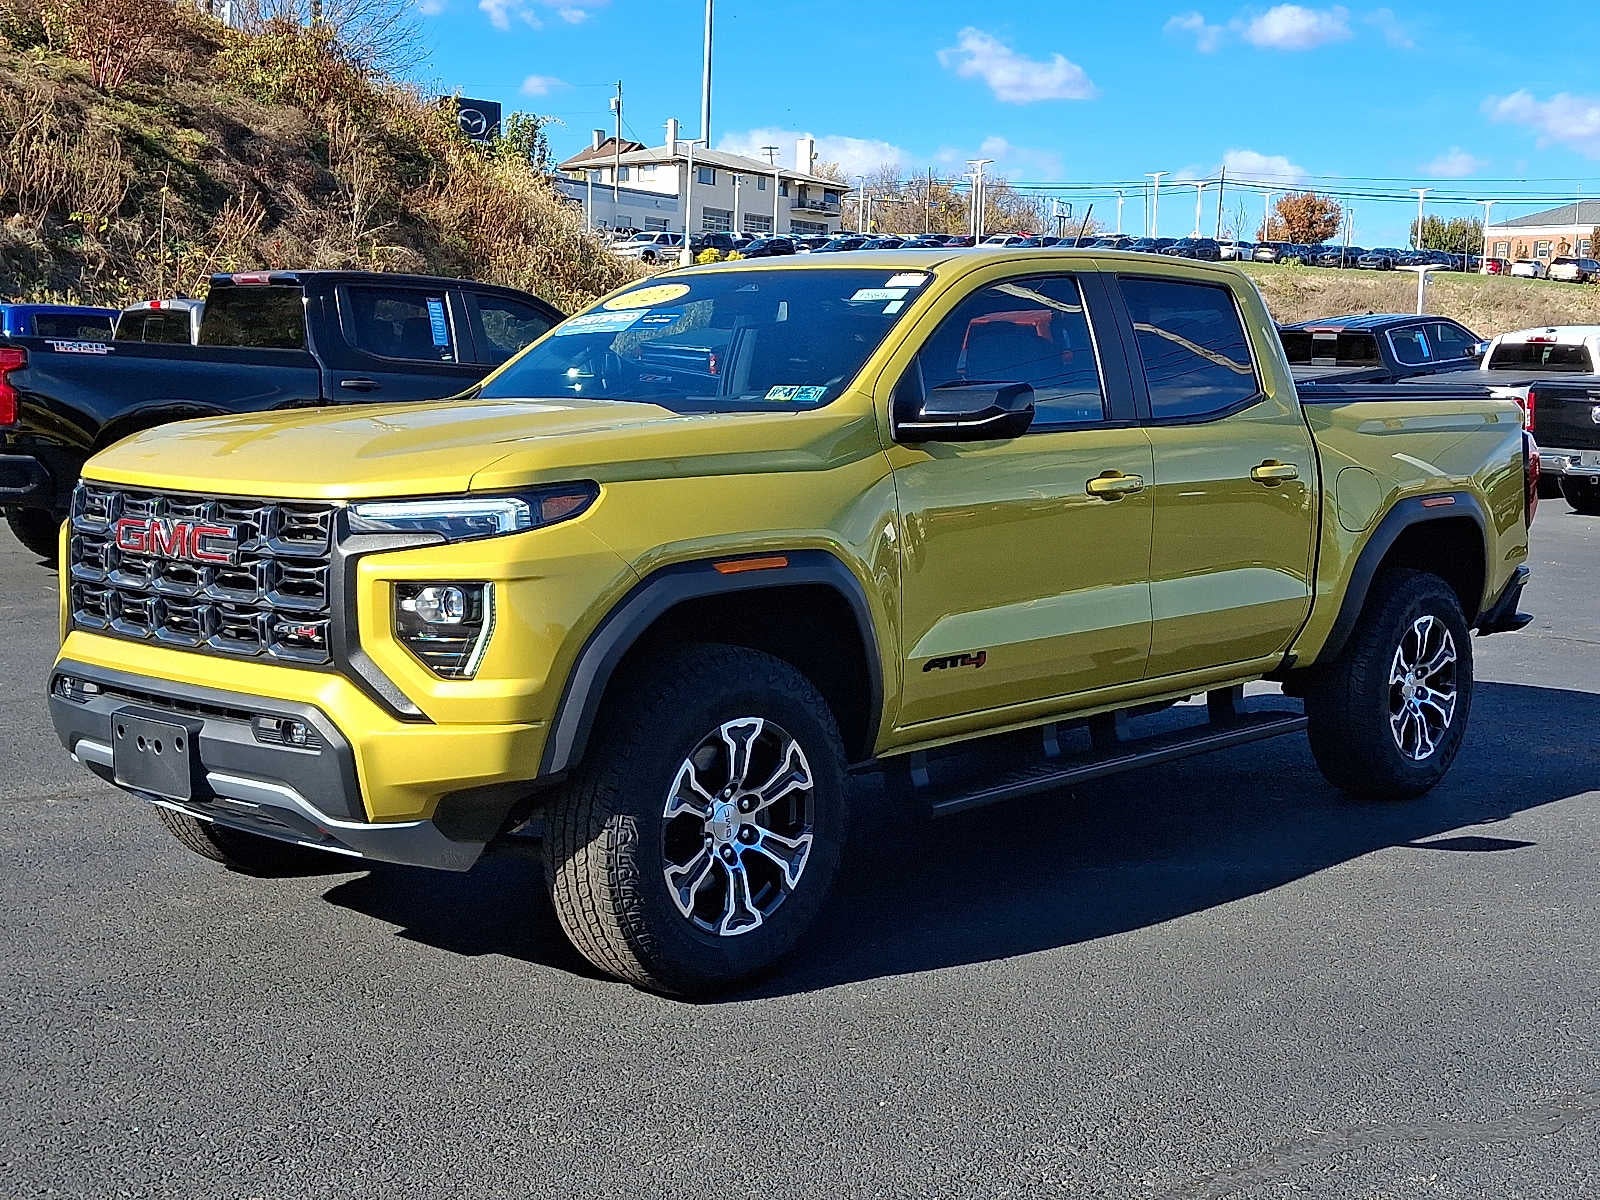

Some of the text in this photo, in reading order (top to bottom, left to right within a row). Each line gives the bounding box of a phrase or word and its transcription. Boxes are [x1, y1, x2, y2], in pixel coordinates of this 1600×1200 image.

[115, 517, 236, 565] GMC
[922, 650, 987, 673] AT4
[723, 808, 732, 839] GMC
